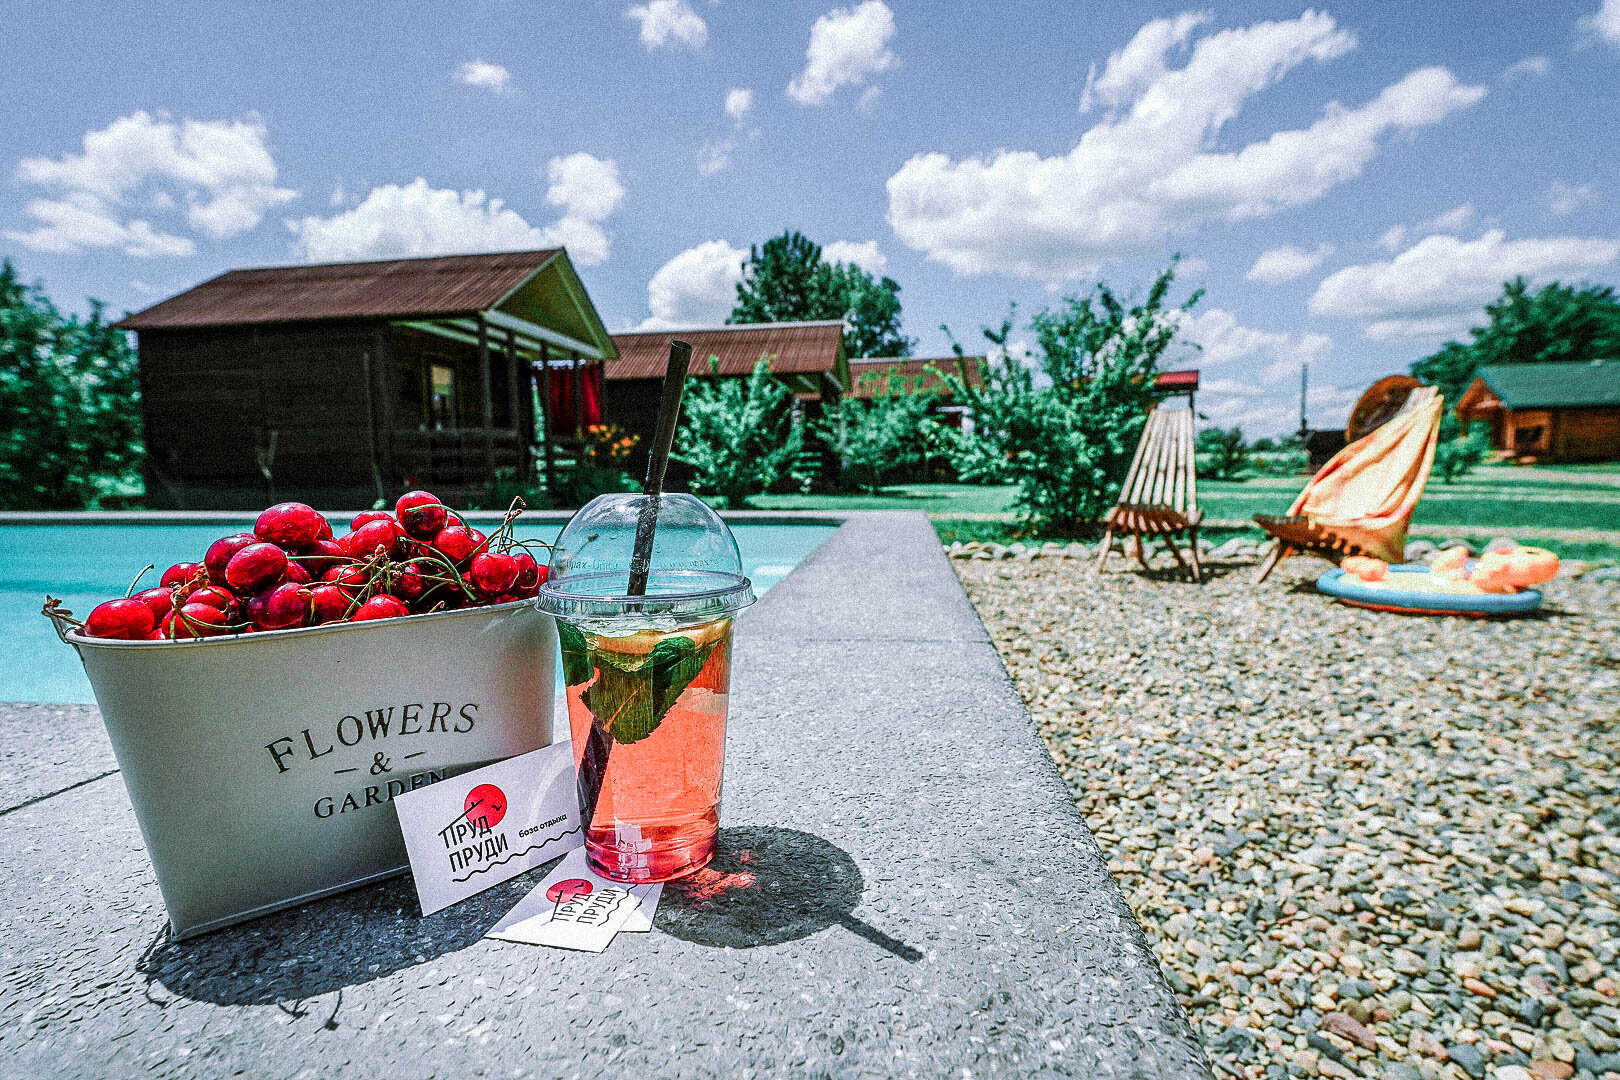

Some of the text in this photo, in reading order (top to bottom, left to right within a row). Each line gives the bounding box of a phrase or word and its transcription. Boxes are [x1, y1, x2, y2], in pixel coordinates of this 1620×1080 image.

[265, 703, 478, 774] FLOWERS
[369, 751, 393, 775] &
[438, 812, 492, 849] ПРУД
[539, 814, 567, 828] отдыха
[448, 833, 509, 872] ПРУДИ
[551, 892, 595, 922] ПРУД
[576, 888, 624, 924] ПРУДИ
